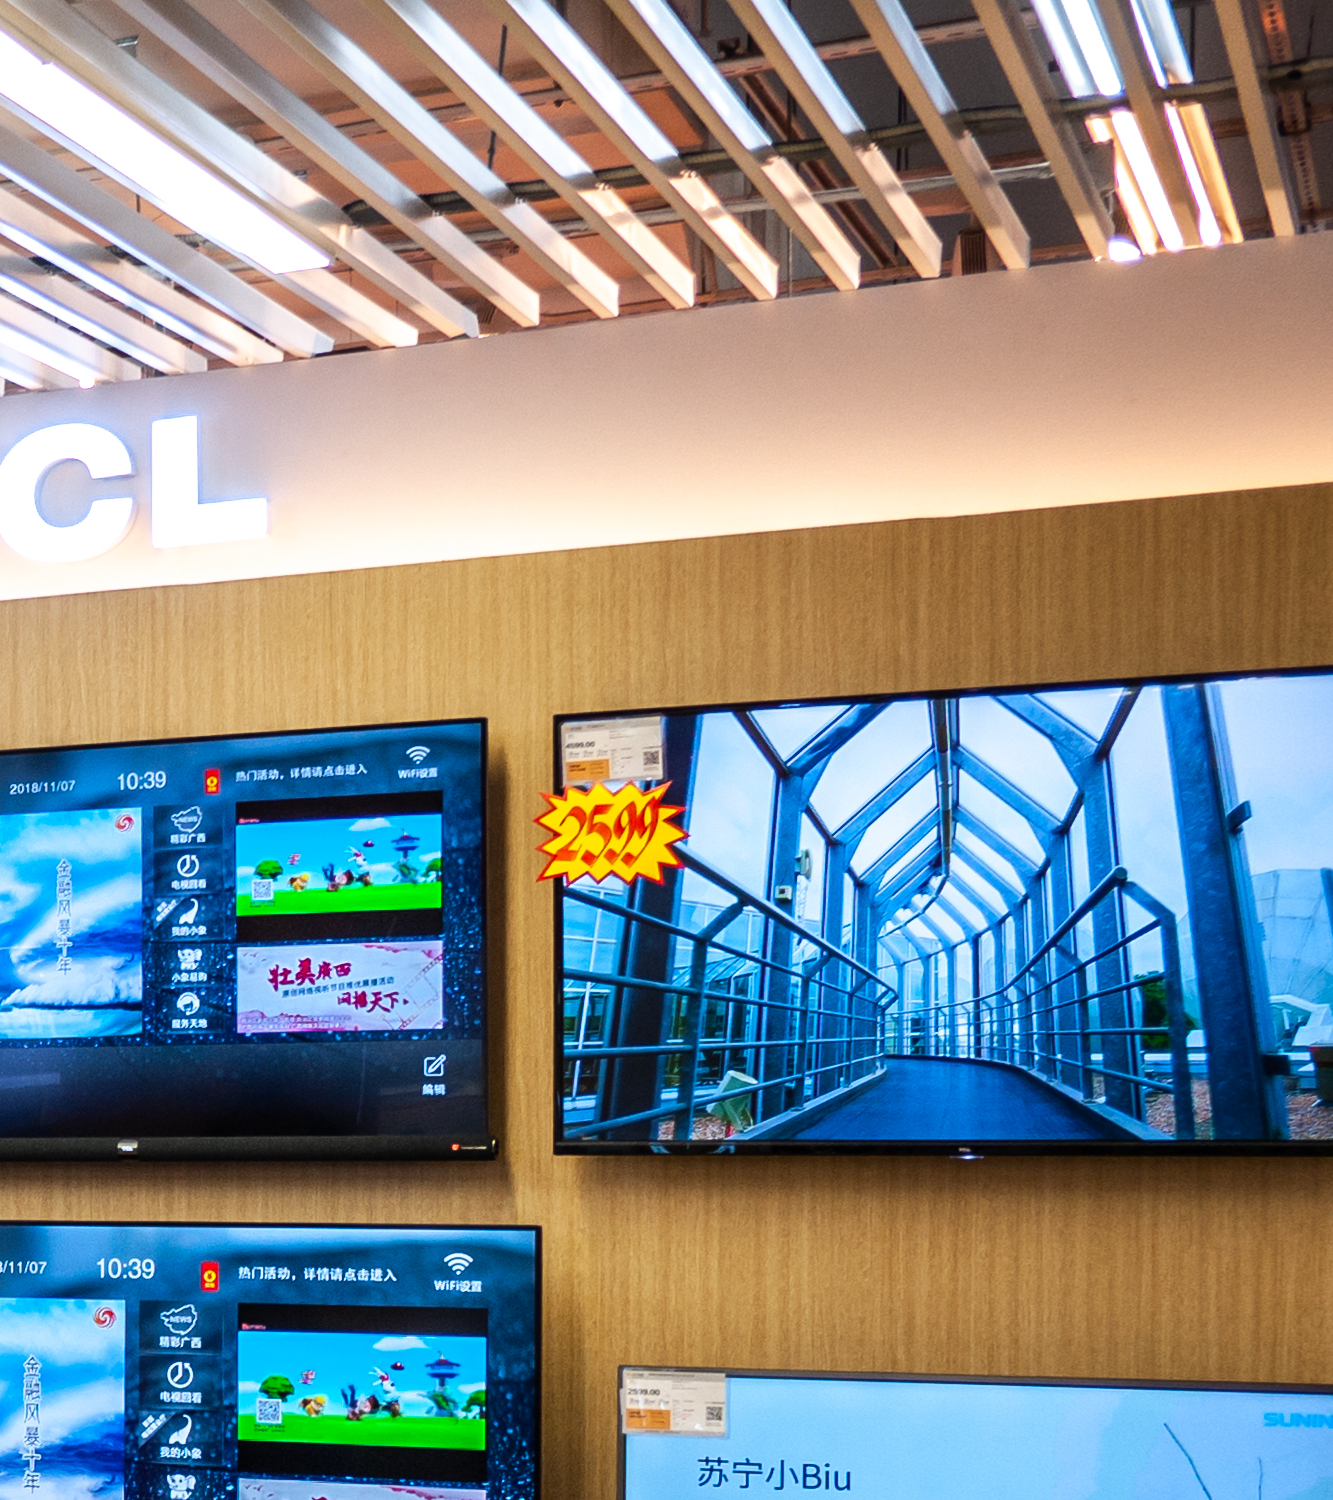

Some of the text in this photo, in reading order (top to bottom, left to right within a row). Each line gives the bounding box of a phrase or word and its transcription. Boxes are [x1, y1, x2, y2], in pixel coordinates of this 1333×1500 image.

[117, 772, 167, 791] 10:39
[398, 767, 438, 779] WiFi设置
[10, 778, 76, 796] 2018/11/07
[555, 797, 659, 868] 2599
[422, 1083, 446, 1096] 编辑
[96, 1258, 155, 1280] 10:39
[434, 1280, 482, 1293] WiFi设置
[159, 1337, 202, 1348] 精彩广西
[697, 1456, 852, 1492] 苏宁小Biu
